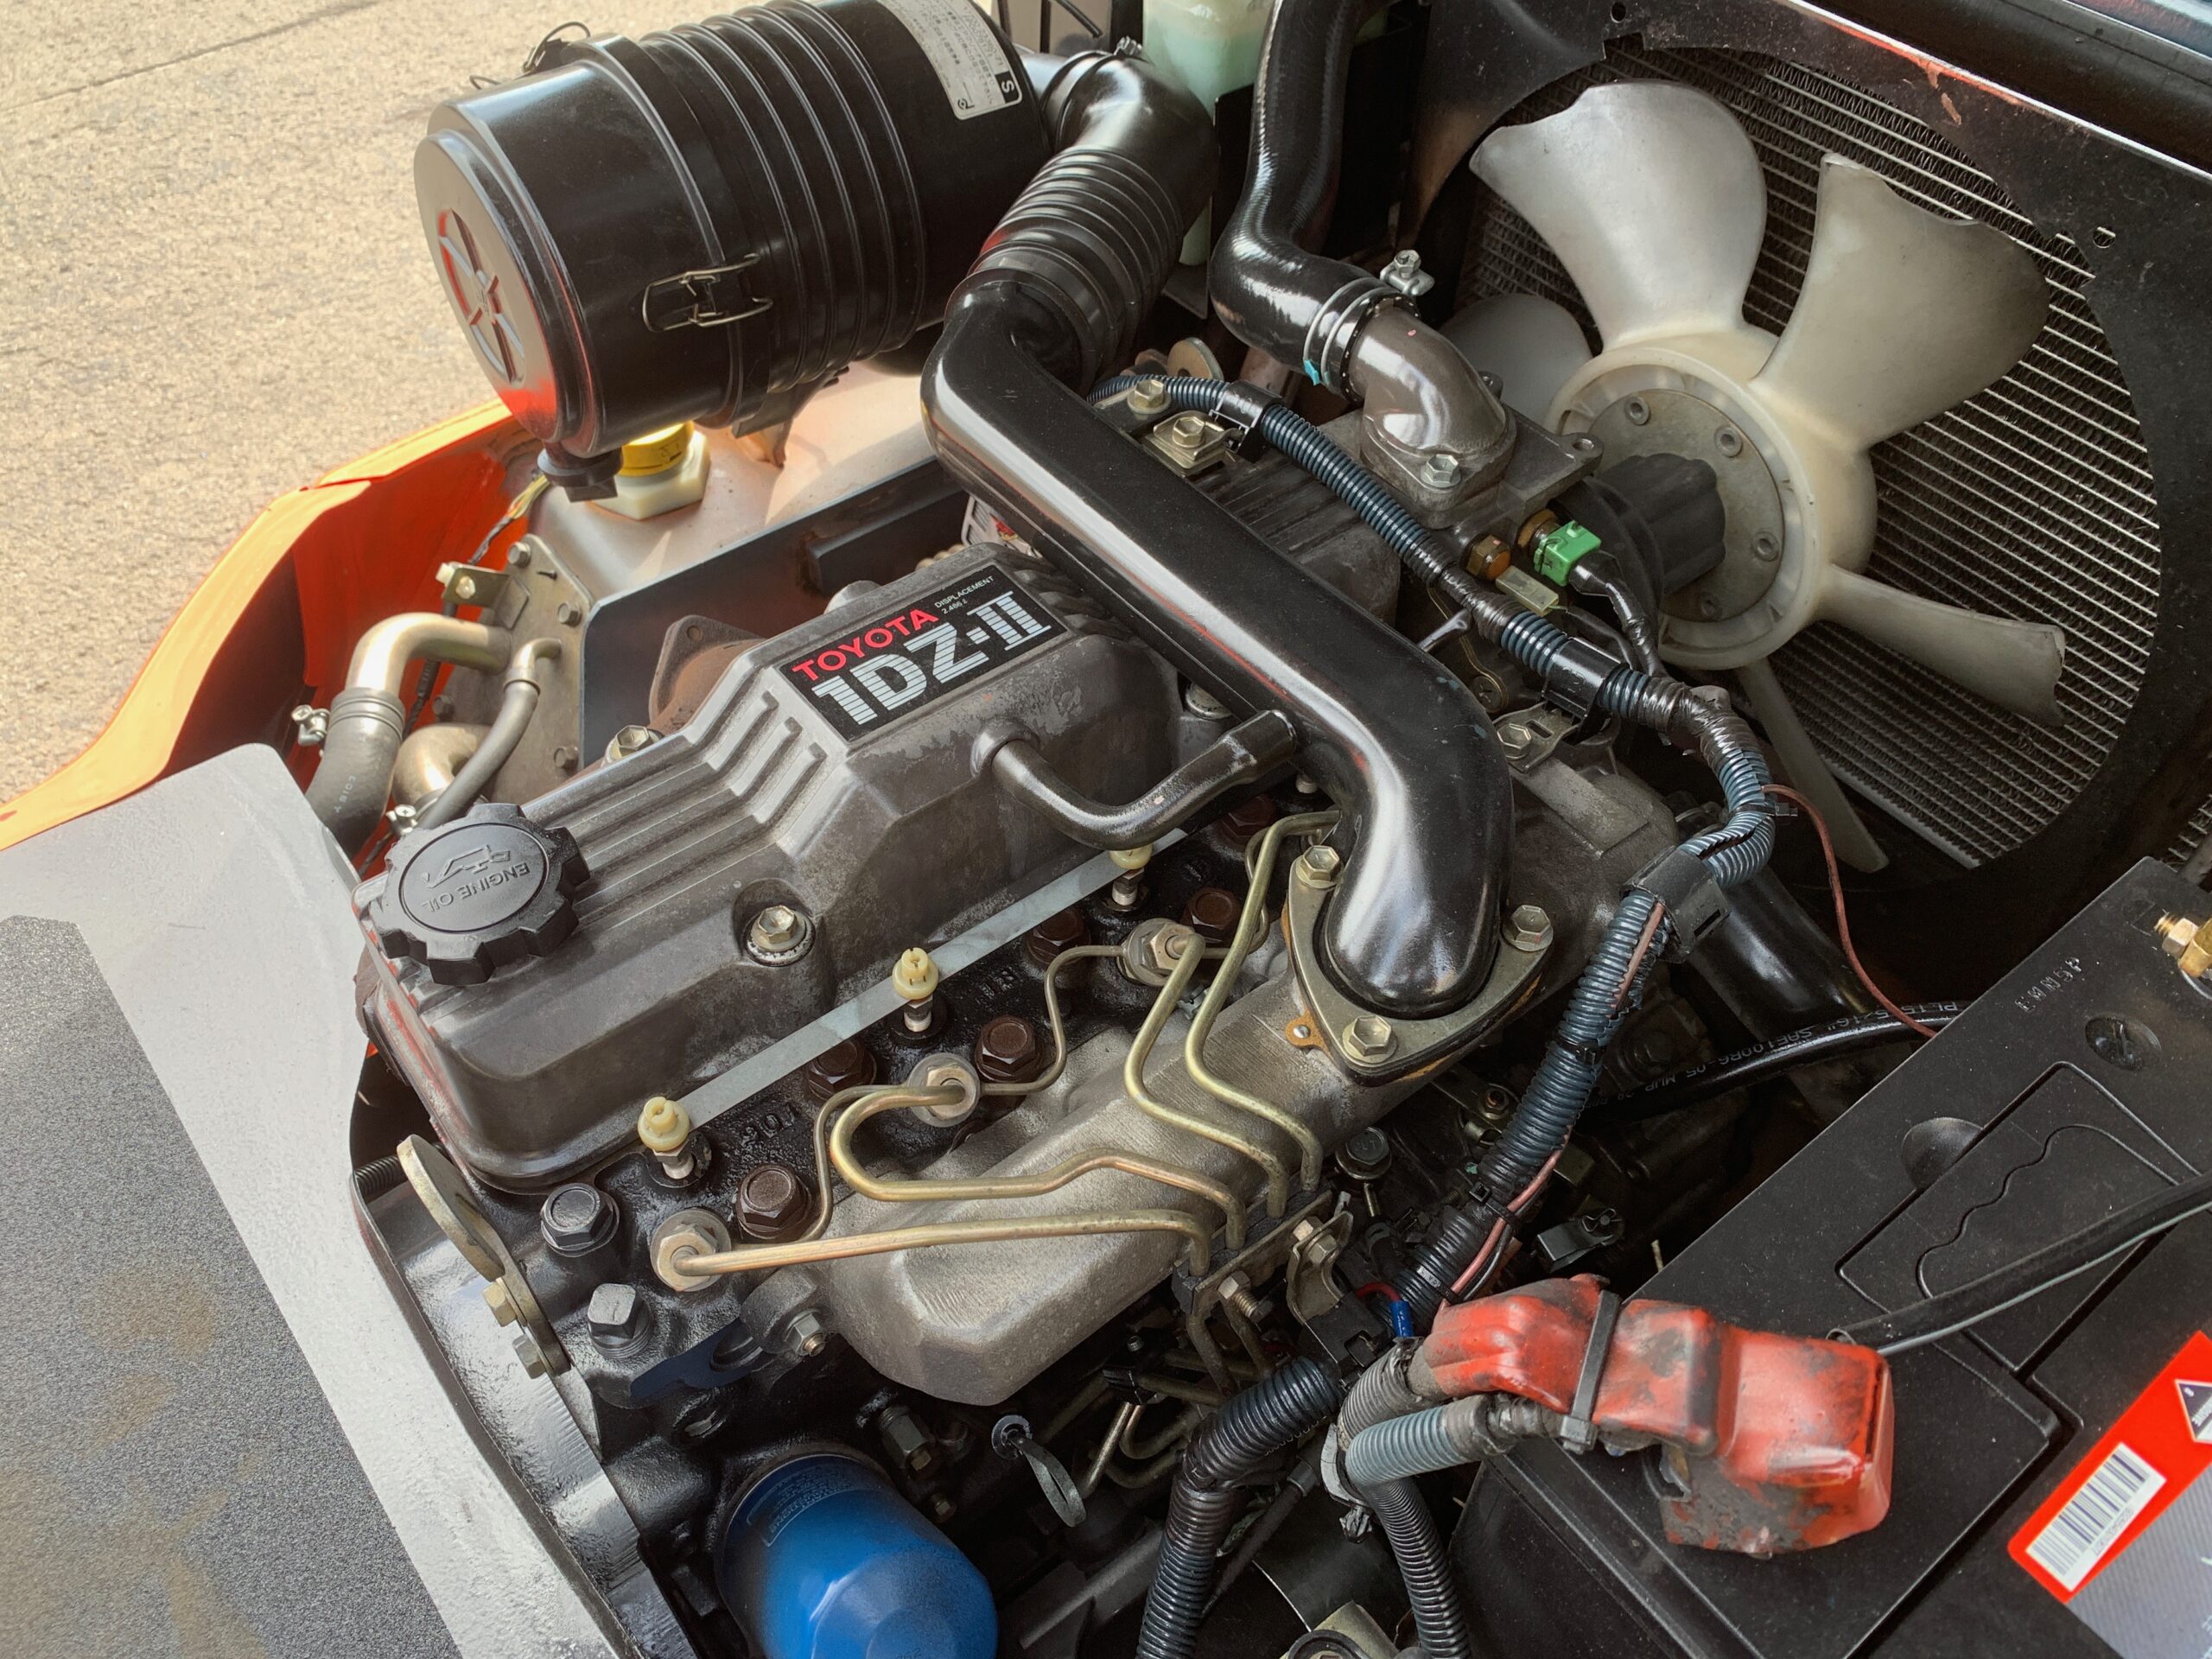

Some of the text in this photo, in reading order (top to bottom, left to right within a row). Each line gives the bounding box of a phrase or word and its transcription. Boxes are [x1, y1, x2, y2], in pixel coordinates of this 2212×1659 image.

[934, 575, 995, 608] DISPLACEMENT
[941, 601, 963, 614] 2.486
[791, 607, 939, 681] TOYOTA
[421, 862, 530, 912] ENGINE OIL
